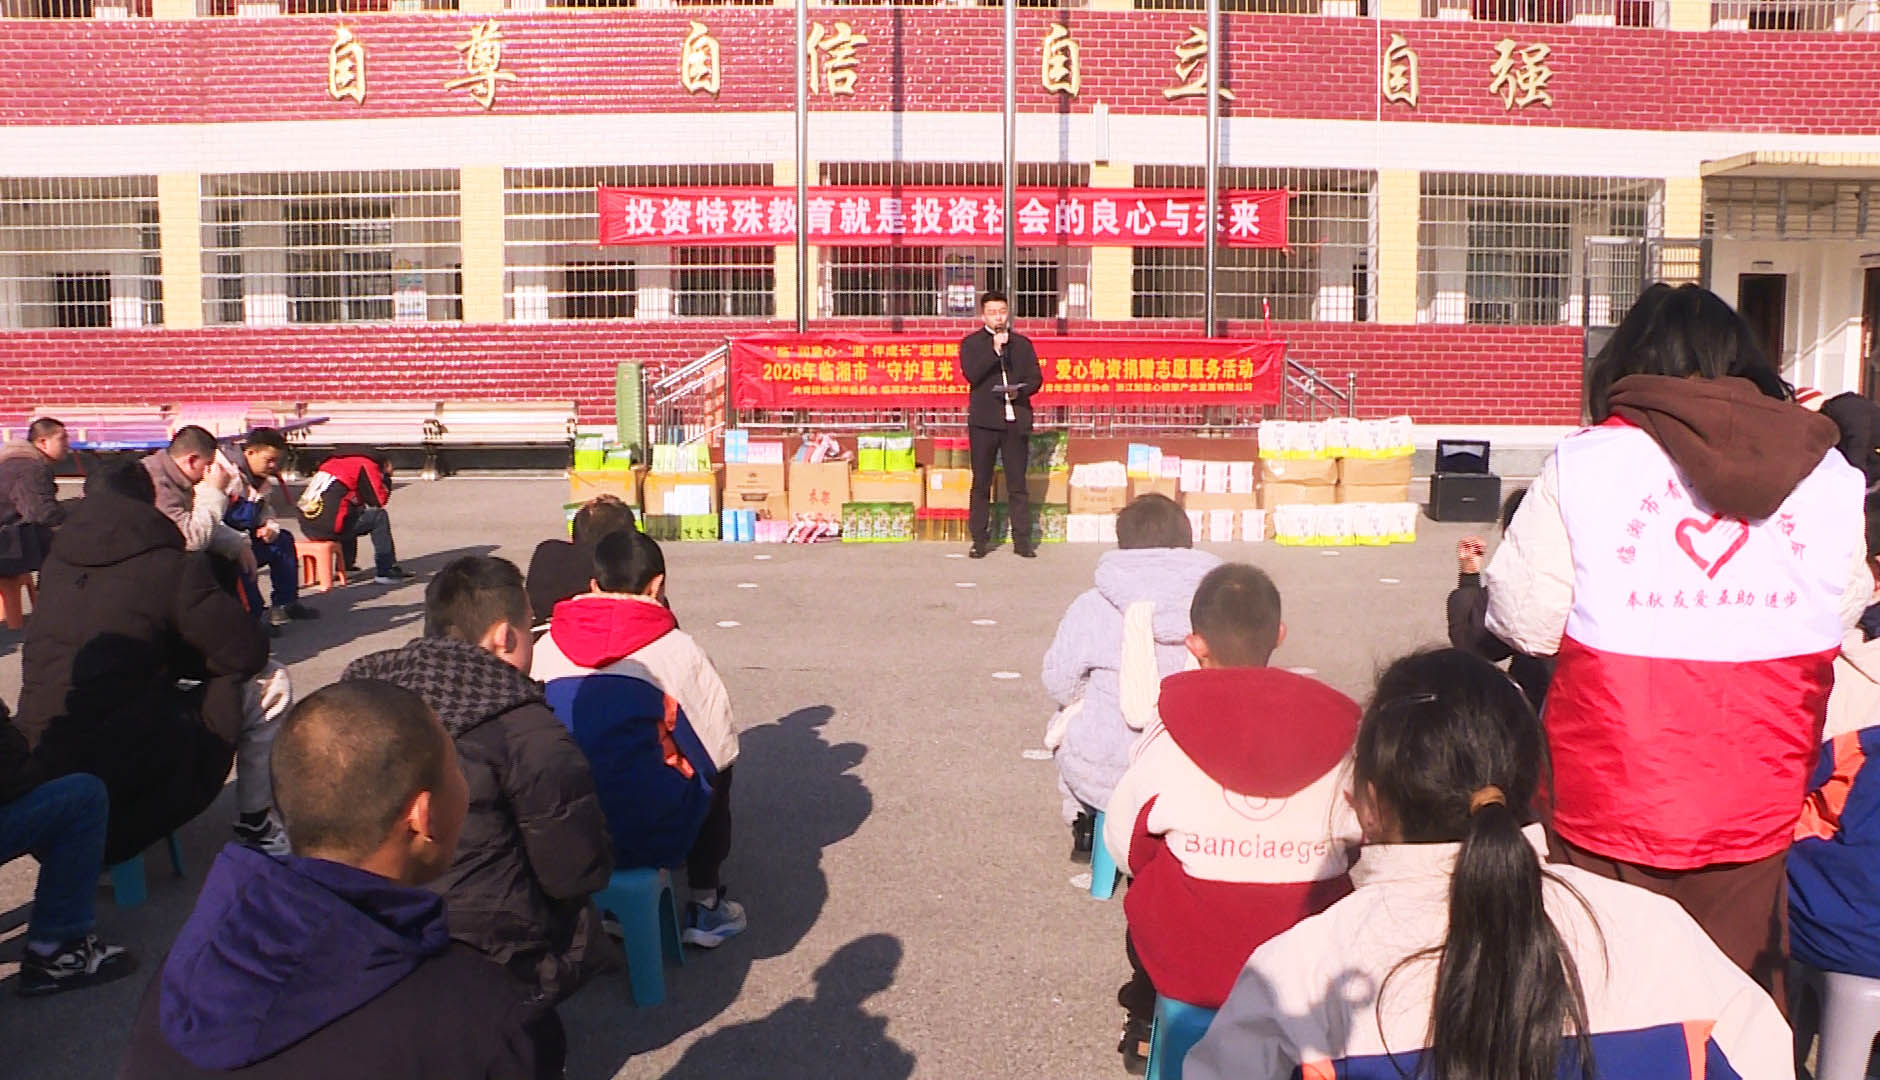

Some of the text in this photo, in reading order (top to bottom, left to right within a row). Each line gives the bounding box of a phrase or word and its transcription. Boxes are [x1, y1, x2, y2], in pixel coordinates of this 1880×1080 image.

[326, 19, 1555, 111] 自尊 自信 自立 自强
